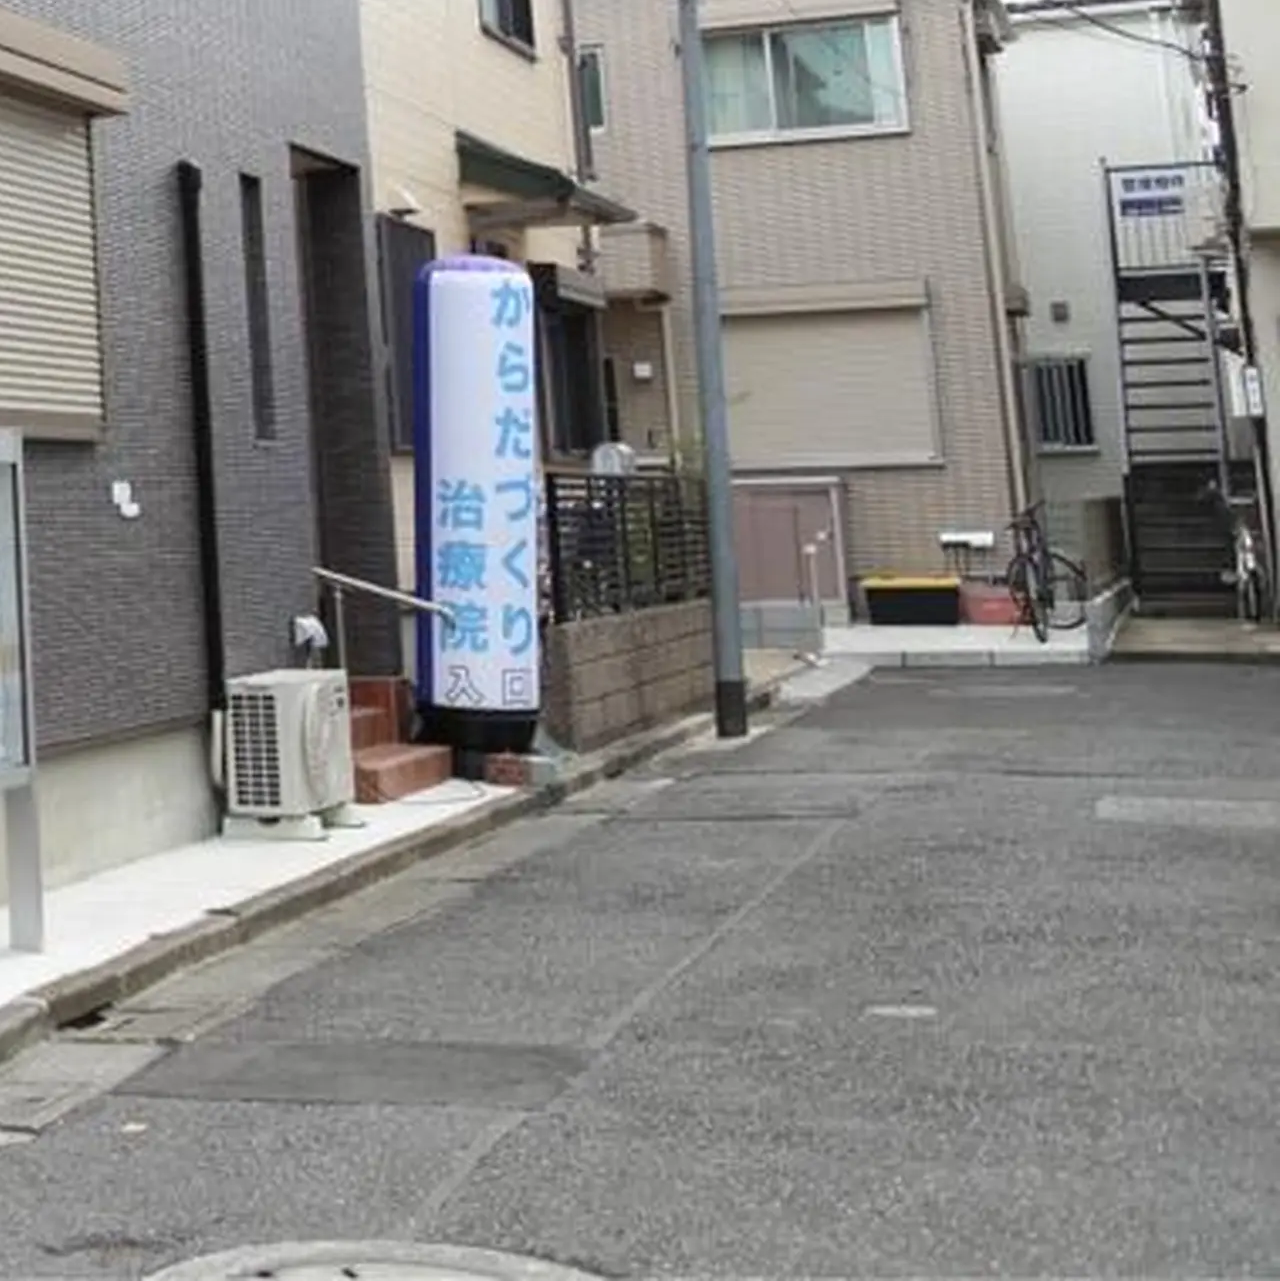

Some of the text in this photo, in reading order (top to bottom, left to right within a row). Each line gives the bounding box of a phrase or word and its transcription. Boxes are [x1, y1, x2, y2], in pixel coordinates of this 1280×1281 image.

[437, 477, 489, 654] 治療院
[490, 278, 533, 656] からだづくり
